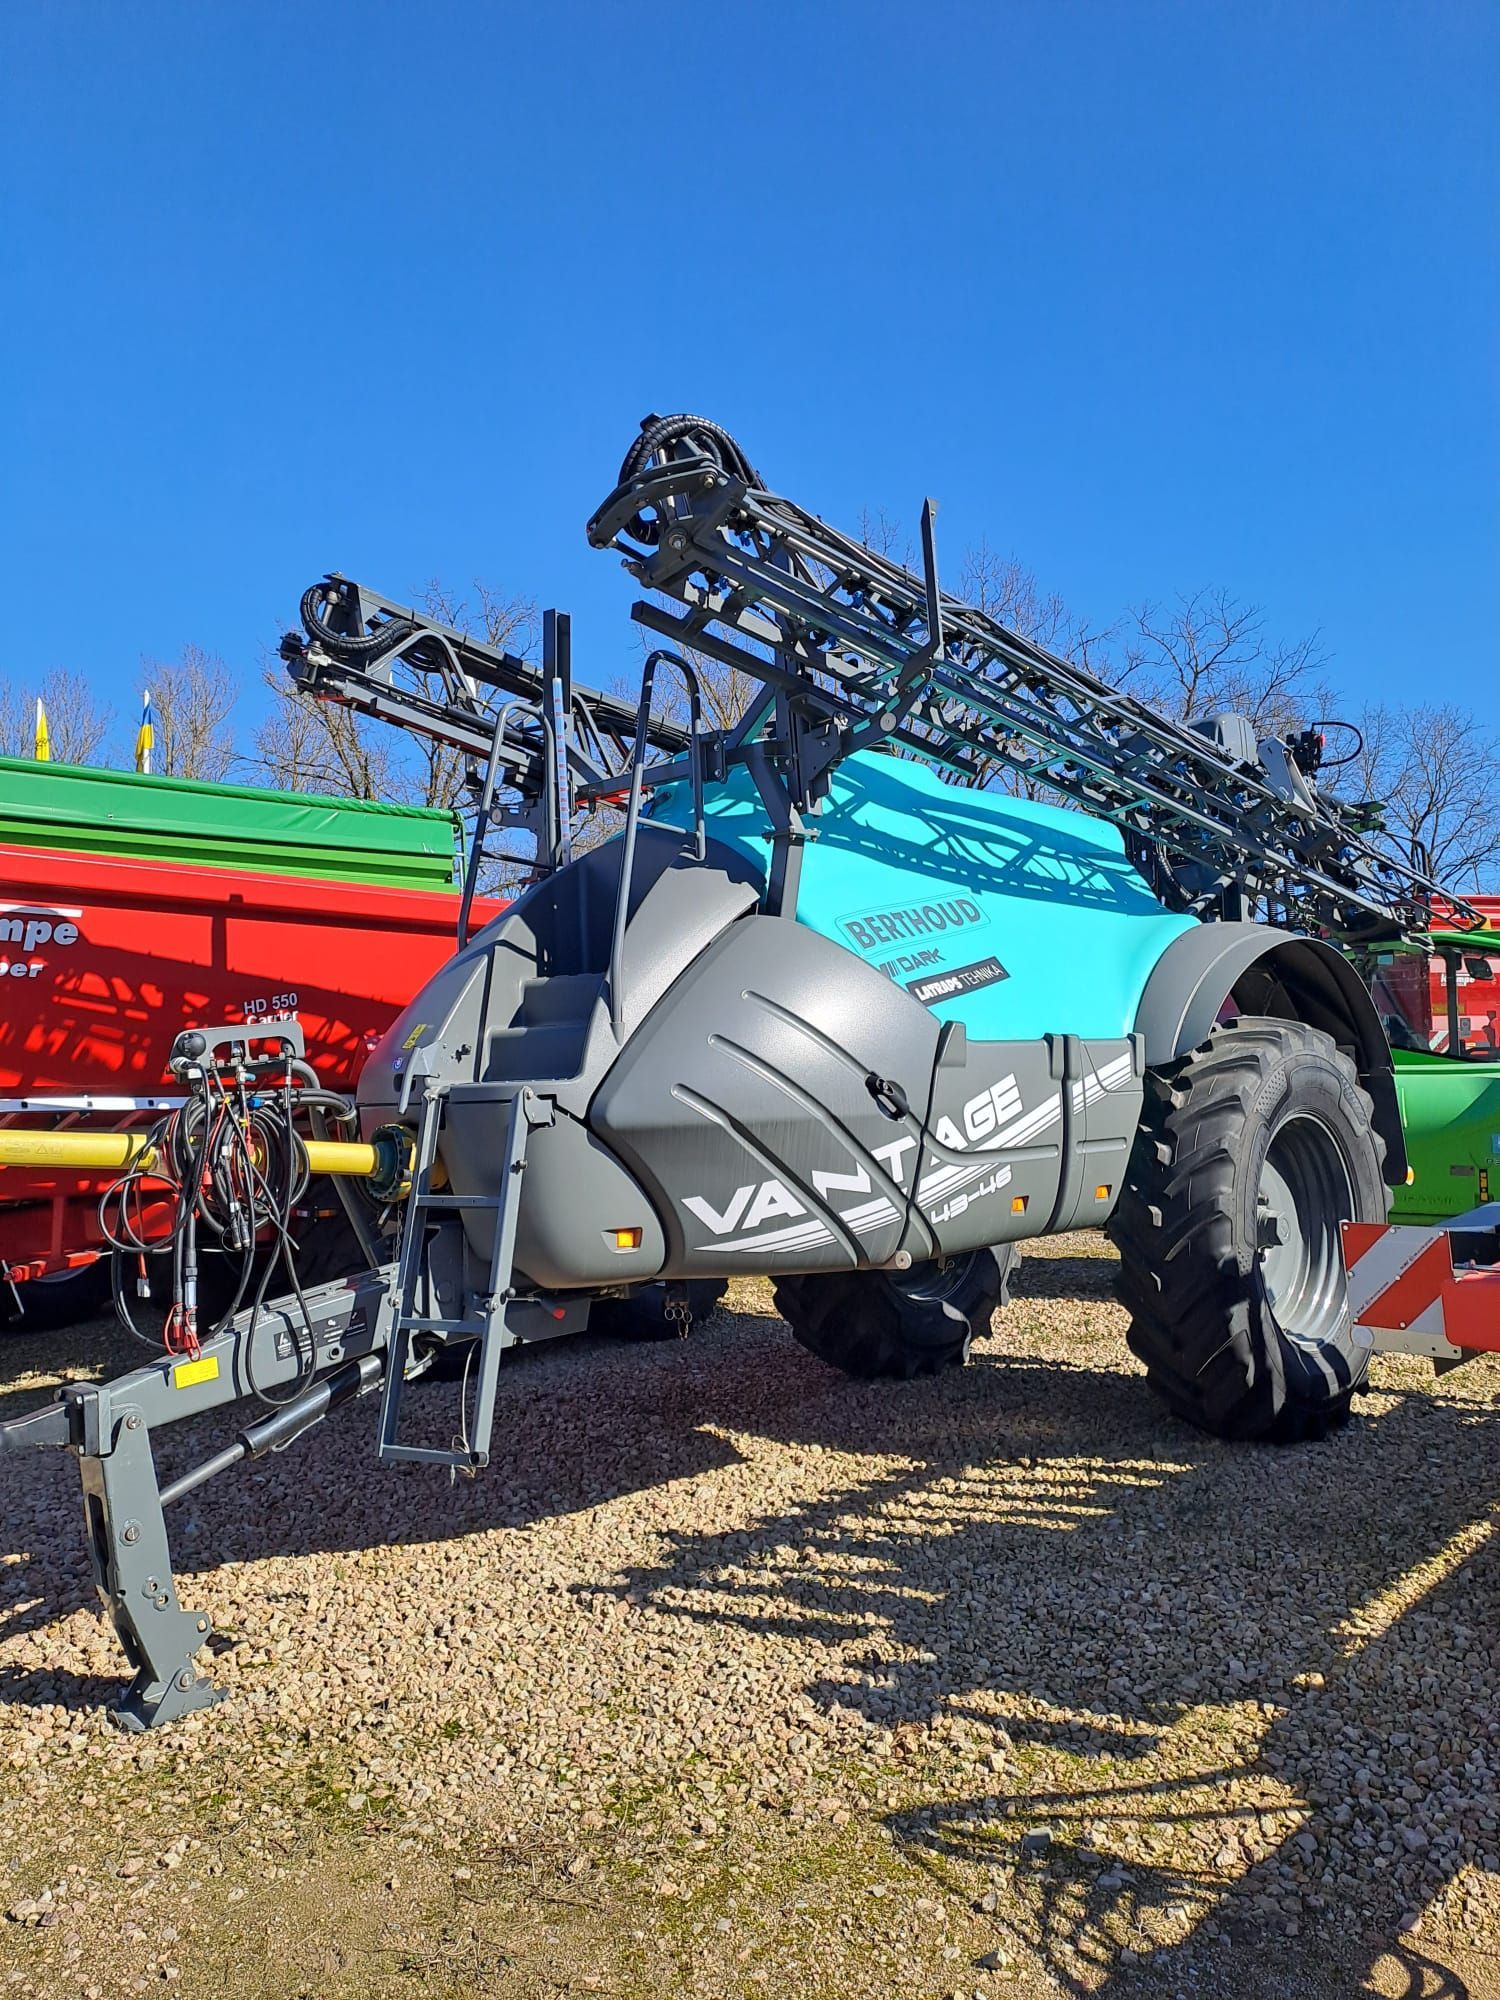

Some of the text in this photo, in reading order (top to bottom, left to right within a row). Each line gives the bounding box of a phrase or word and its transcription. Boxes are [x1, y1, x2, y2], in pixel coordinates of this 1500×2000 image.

[845, 899, 981, 949] BERTHOUD
[896, 948, 946, 973] DARK
[914, 964, 1003, 1001] LATRAPS TEHNIKA
[244, 993, 298, 1015] HD 550
[246, 1010, 299, 1025] Carrier
[681, 1072, 1023, 1235] VANTAGE
[930, 1164, 1012, 1225] 43-46
